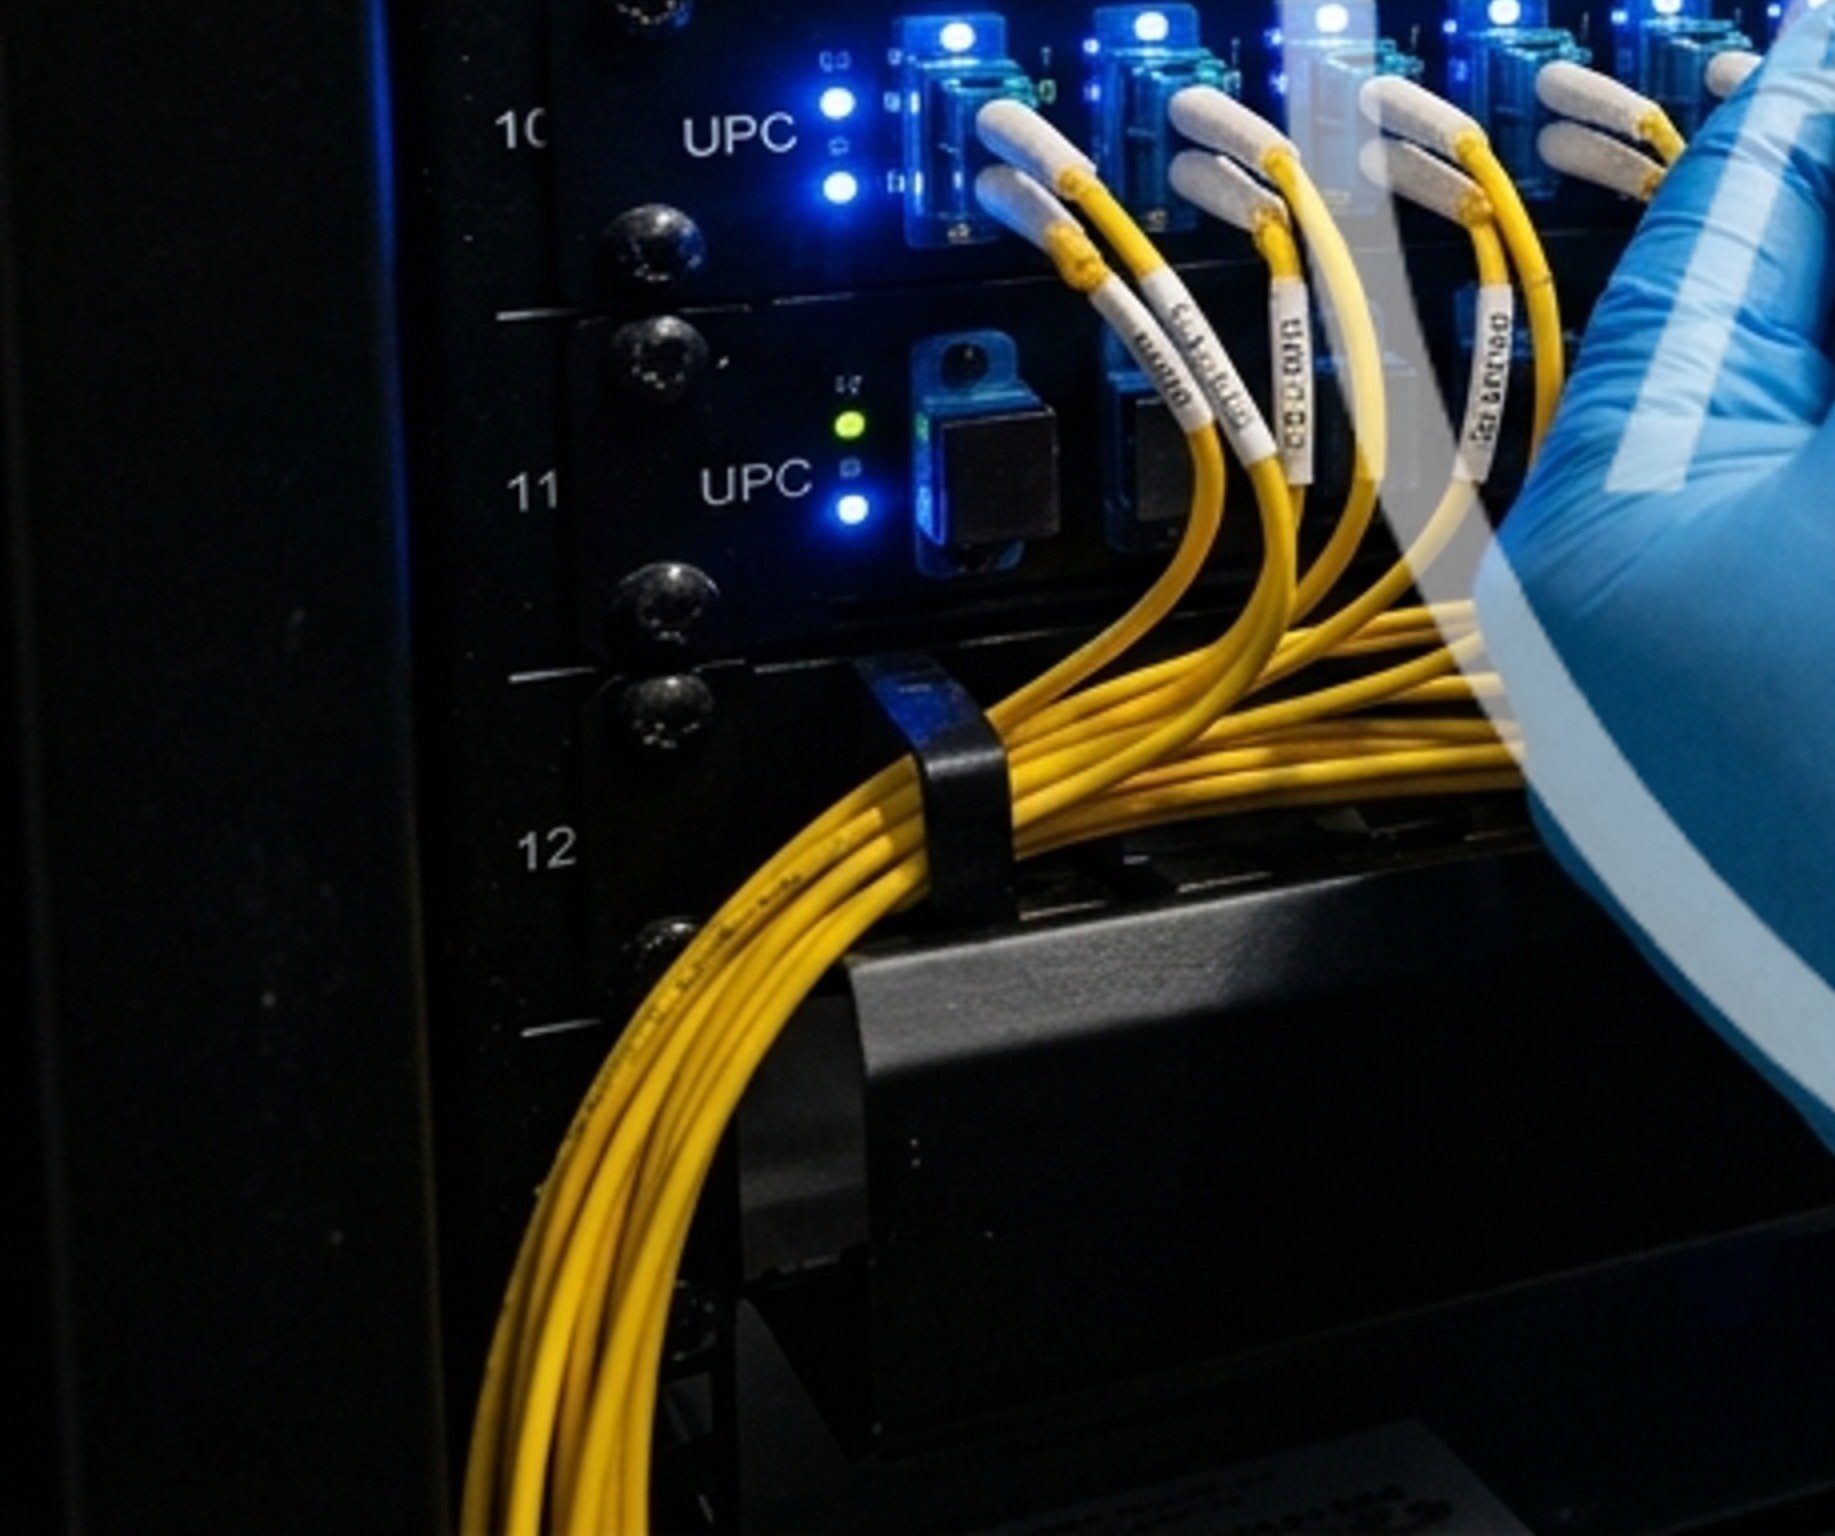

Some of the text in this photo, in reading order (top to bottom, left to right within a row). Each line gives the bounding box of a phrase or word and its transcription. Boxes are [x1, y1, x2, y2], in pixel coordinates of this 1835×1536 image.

[683, 111, 798, 158] UPC
[507, 472, 559, 513] 11
[701, 459, 814, 508] UPC
[517, 825, 577, 871] 12
